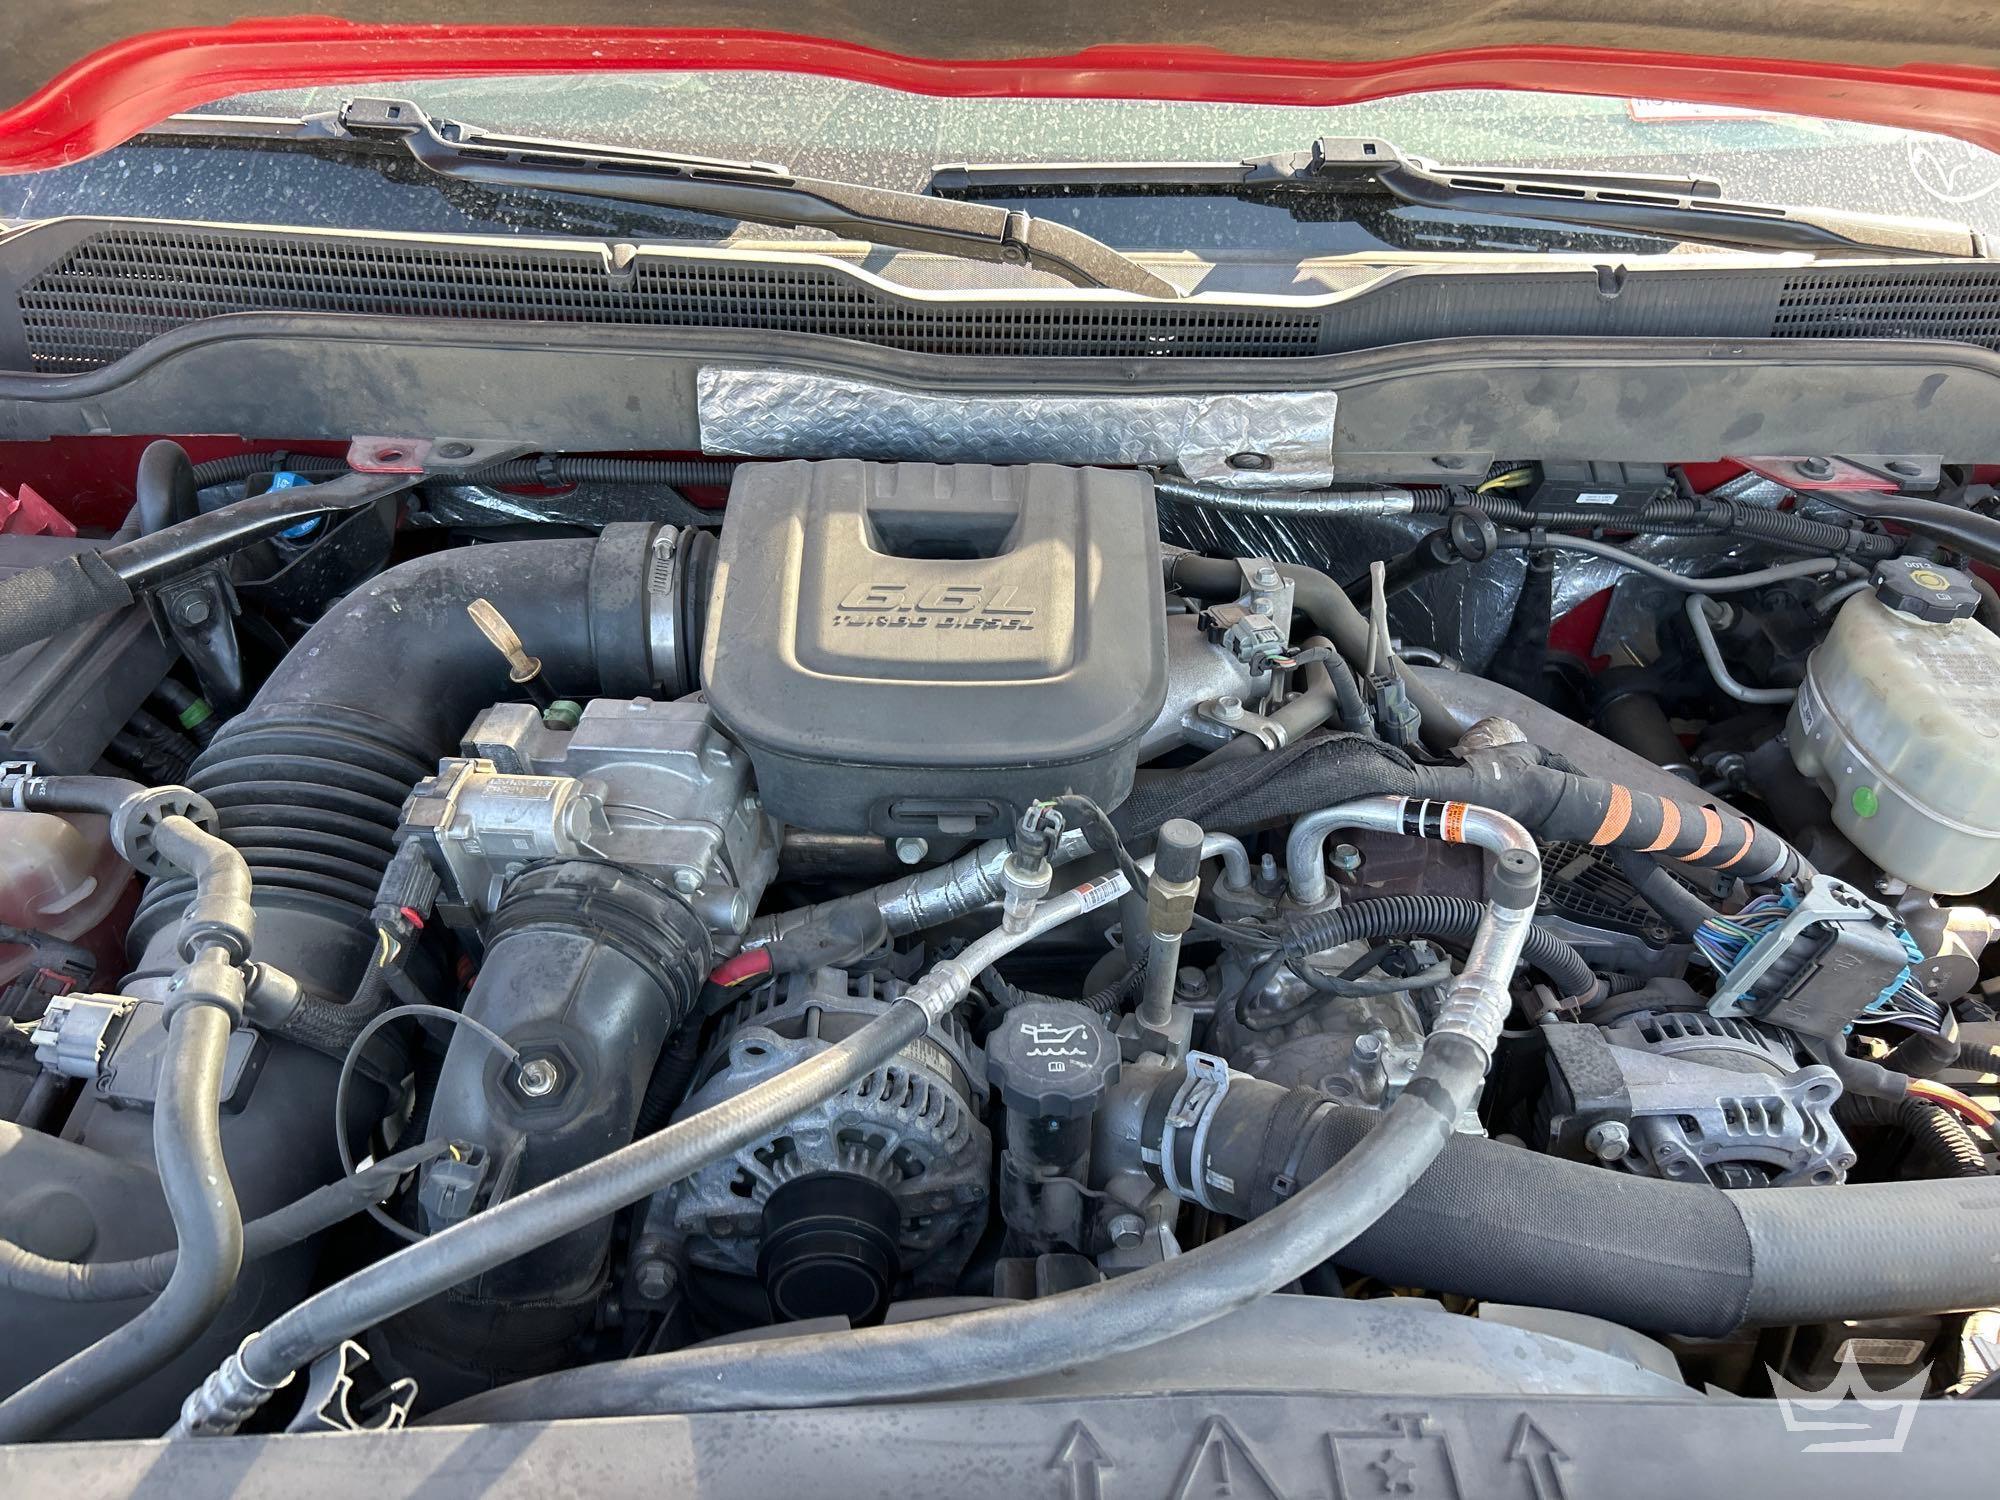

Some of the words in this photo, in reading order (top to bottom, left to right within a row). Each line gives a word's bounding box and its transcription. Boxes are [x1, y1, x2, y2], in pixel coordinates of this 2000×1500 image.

[837, 583, 1036, 614] 6.6L
[832, 615, 930, 628] TURBO
[935, 616, 1035, 631] DIESEL
